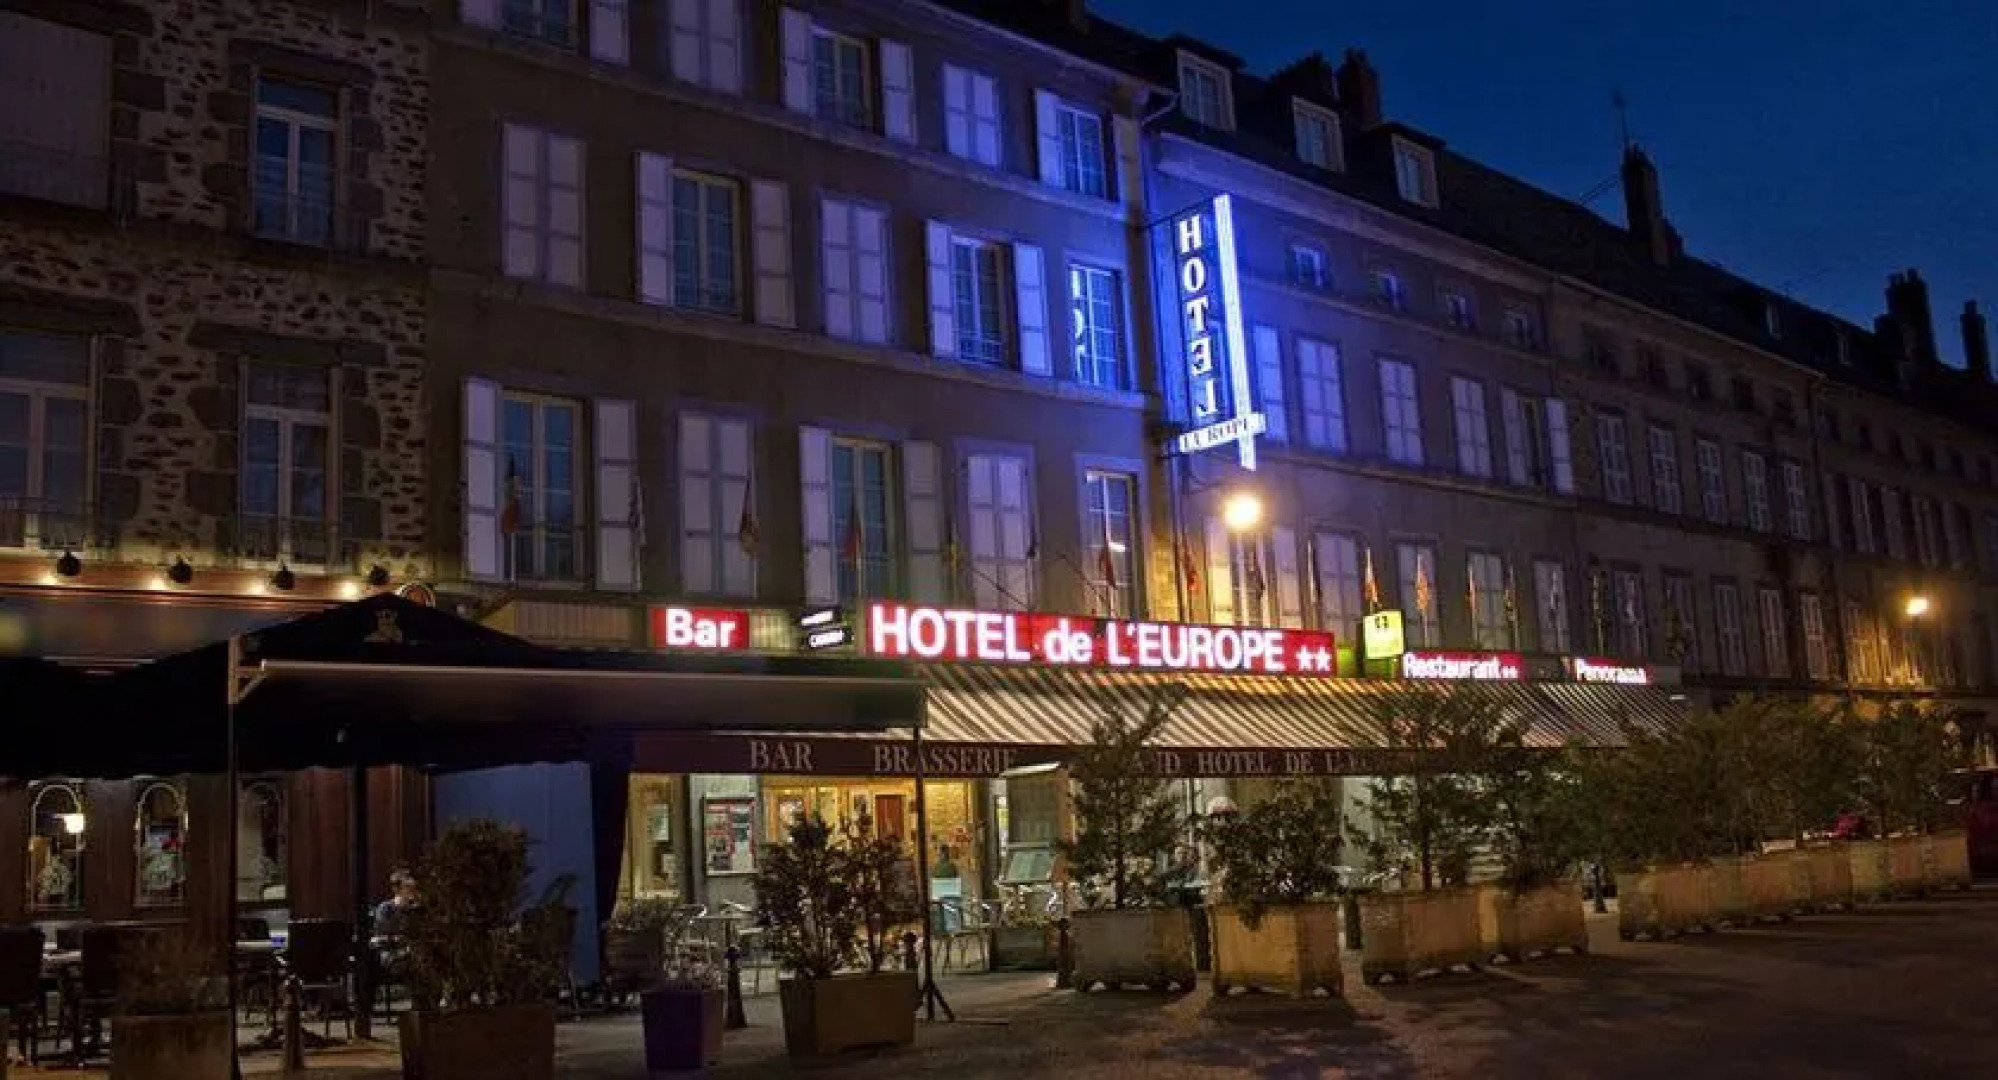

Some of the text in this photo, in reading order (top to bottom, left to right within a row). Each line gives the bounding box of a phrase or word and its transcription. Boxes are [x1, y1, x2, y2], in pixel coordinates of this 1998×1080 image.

[666, 608, 736, 648] Bar
[871, 605, 1285, 671] HOTEL de L'EUROPE
[1403, 652, 1500, 679] Restaurant
[750, 740, 815, 771] BAR
[874, 744, 1016, 774] BRASSERIE
[1198, 751, 1270, 774] HOTEL
[1284, 751, 1314, 774] DE
